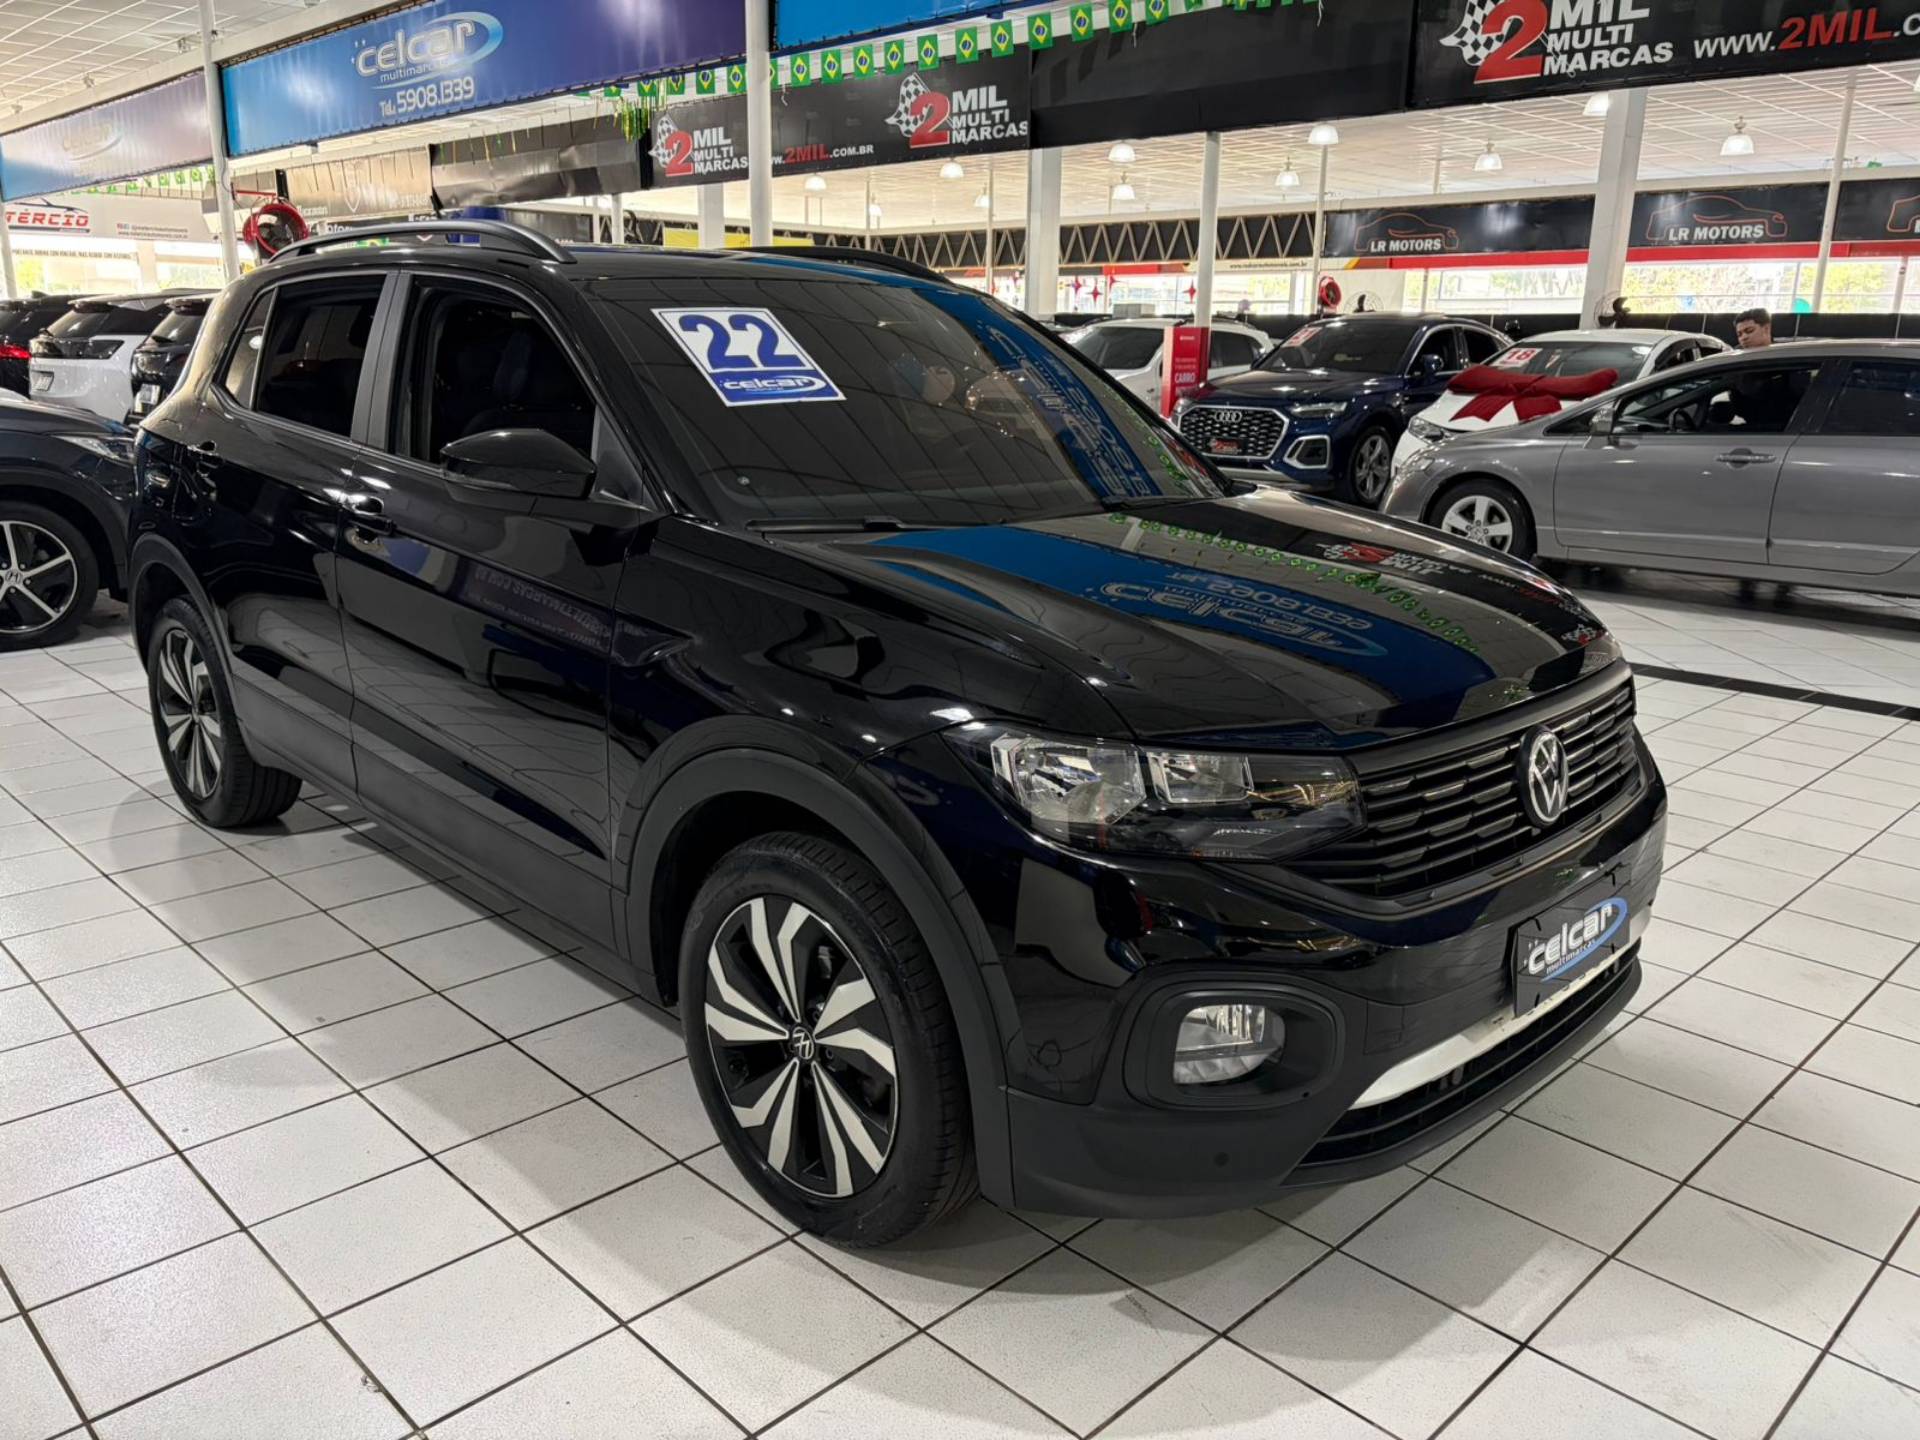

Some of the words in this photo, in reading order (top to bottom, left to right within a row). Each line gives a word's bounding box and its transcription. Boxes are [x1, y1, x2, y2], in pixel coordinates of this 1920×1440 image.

[356, 21, 475, 76] celcar
[1474, 0, 1548, 84] 2
[1550, 0, 1650, 30] MIL
[1547, 23, 1634, 53] MULTI
[1543, 41, 1674, 76] MARCAS
[396, 76, 475, 113] 5908.1339
[909, 90, 950, 149] 2
[952, 85, 1008, 113] MIL
[951, 108, 1010, 129] MULTI
[952, 120, 1028, 144] MARCAS
[665, 131, 693, 177] 2
[693, 126, 732, 149] MIL
[693, 146, 734, 162] MULTI
[694, 156, 749, 175] MARCAS
[1370, 240, 1386, 252] LR
[1389, 238, 1442, 252] MOTORS
[1669, 227, 1690, 241] LR
[1694, 224, 1765, 240] MOTORS
[679, 314, 806, 369] 22
[1507, 350, 1536, 361] 18
[724, 378, 810, 390] celcar
[1529, 902, 1613, 975] celcar
